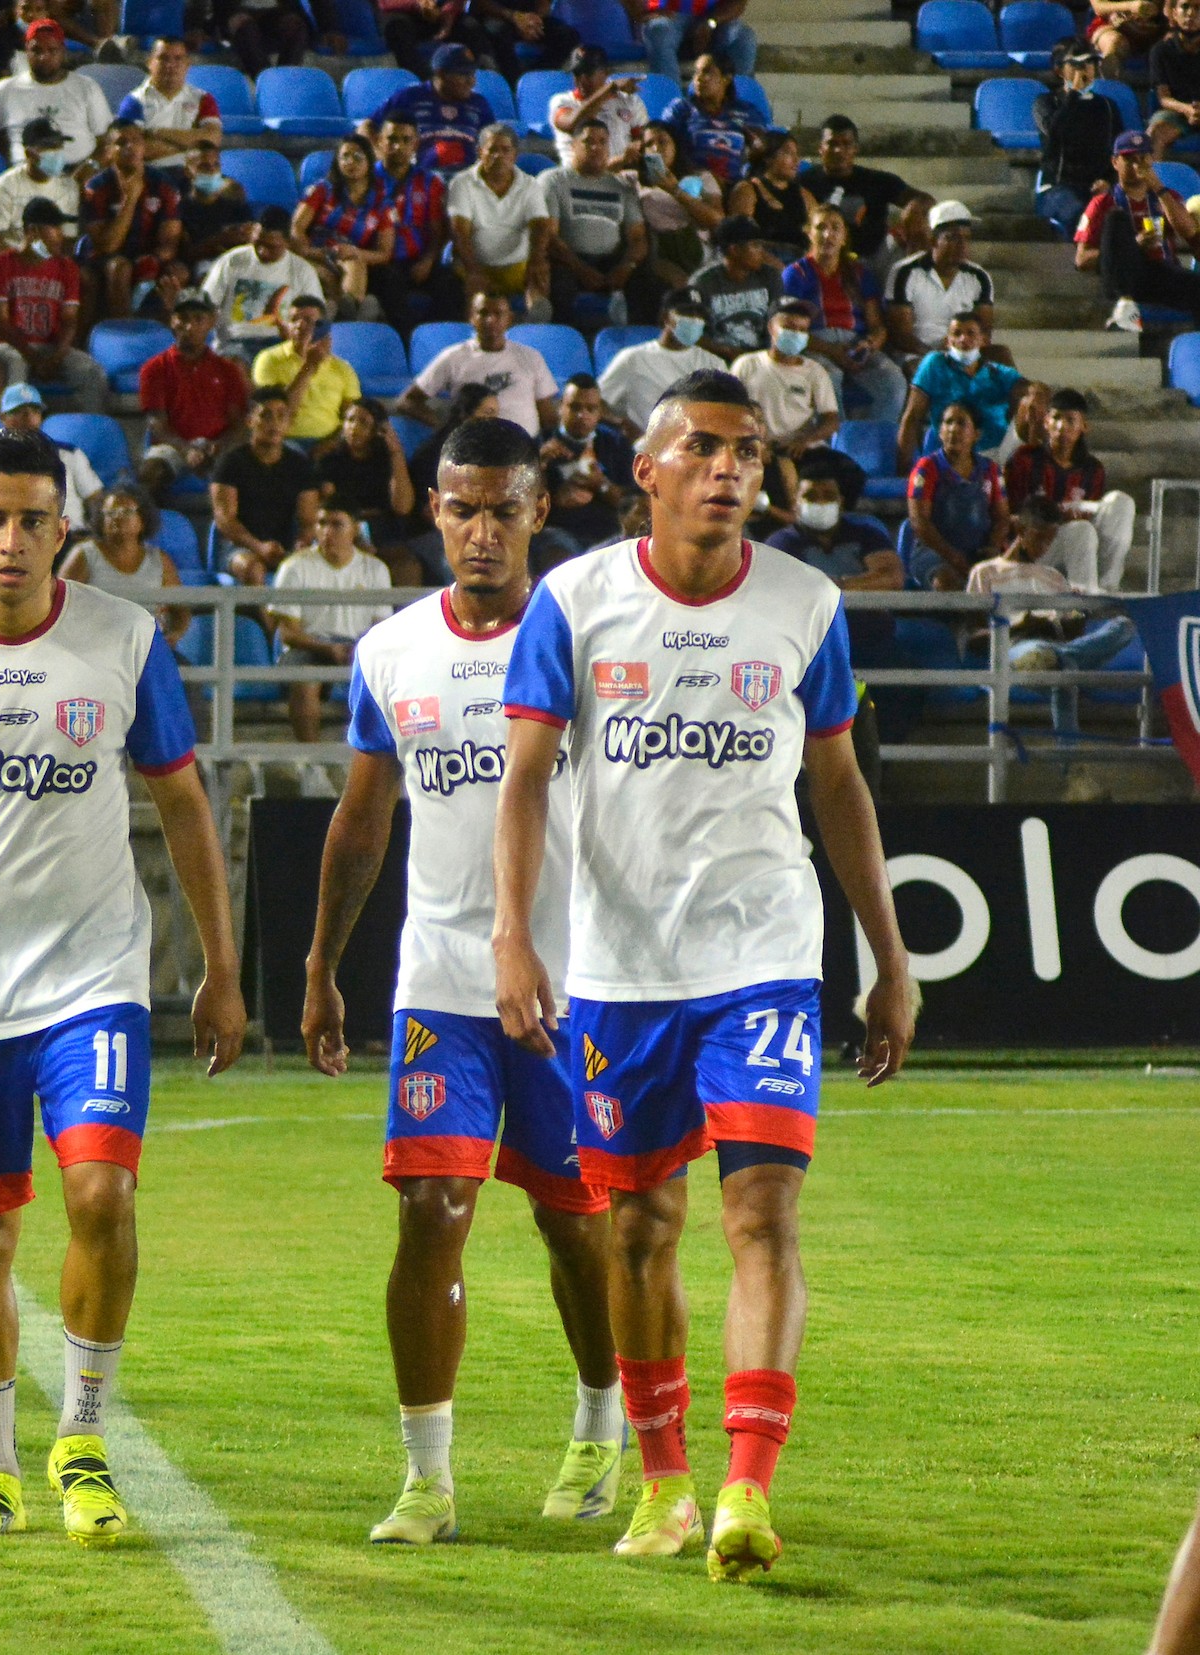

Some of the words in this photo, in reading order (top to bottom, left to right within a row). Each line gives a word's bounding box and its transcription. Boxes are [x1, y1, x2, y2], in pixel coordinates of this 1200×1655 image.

[663, 631, 730, 650] Wplay.co
[676, 675, 714, 687] FSS
[605, 713, 776, 769] Wplay.co
[745, 1008, 813, 1076] 24
[93, 1030, 127, 1092] 11
[756, 1078, 799, 1095] FSS
[82, 1099, 125, 1113] FSS
